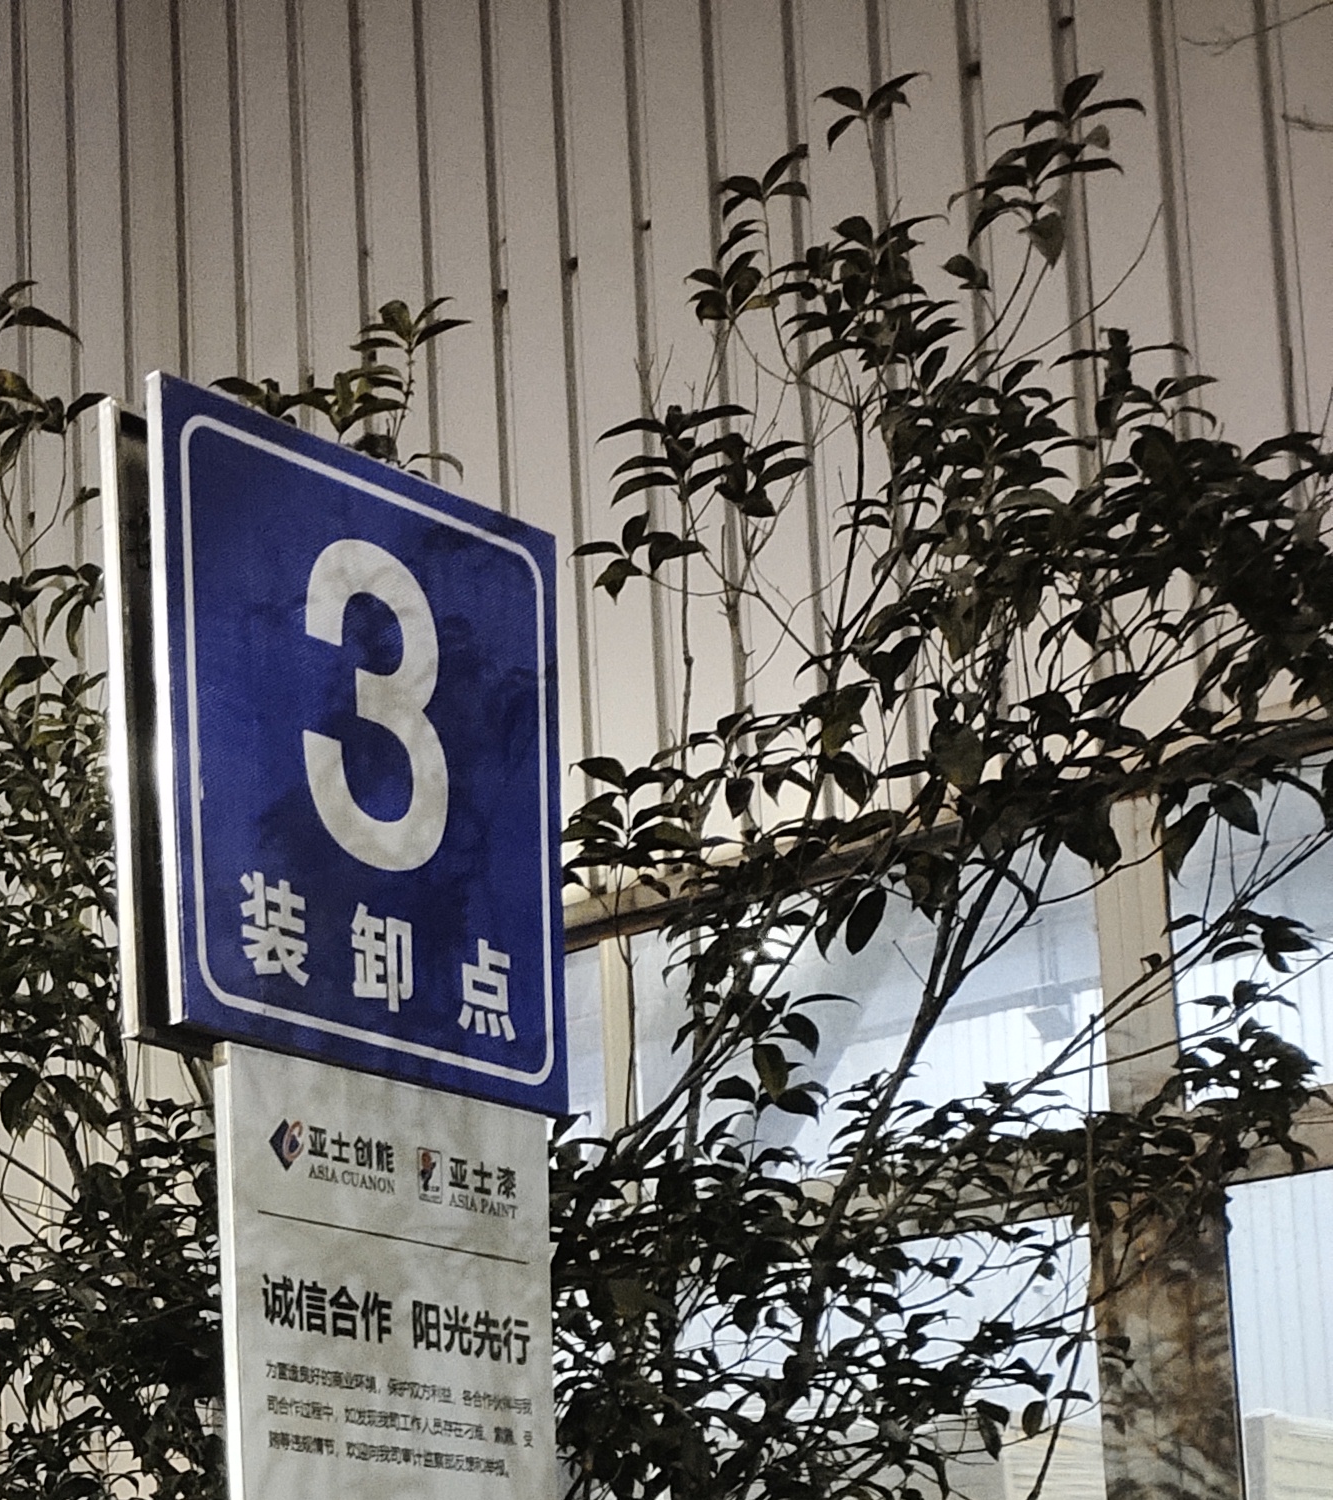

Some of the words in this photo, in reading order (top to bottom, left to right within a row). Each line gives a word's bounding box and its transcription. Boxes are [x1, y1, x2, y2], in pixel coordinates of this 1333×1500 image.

[303, 539, 449, 872] 3
[239, 872, 517, 1042] 装卸点
[308, 1126, 395, 1173] 亚士创能
[309, 1164, 339, 1184] ASIA
[341, 1169, 396, 1196] CUANON
[448, 1158, 517, 1199] 亚士漆
[449, 1193, 478, 1212] ASIA
[481, 1198, 518, 1219] PAINT
[262, 1273, 393, 1344] 诚信合作
[412, 1300, 532, 1366] 阳光先行
